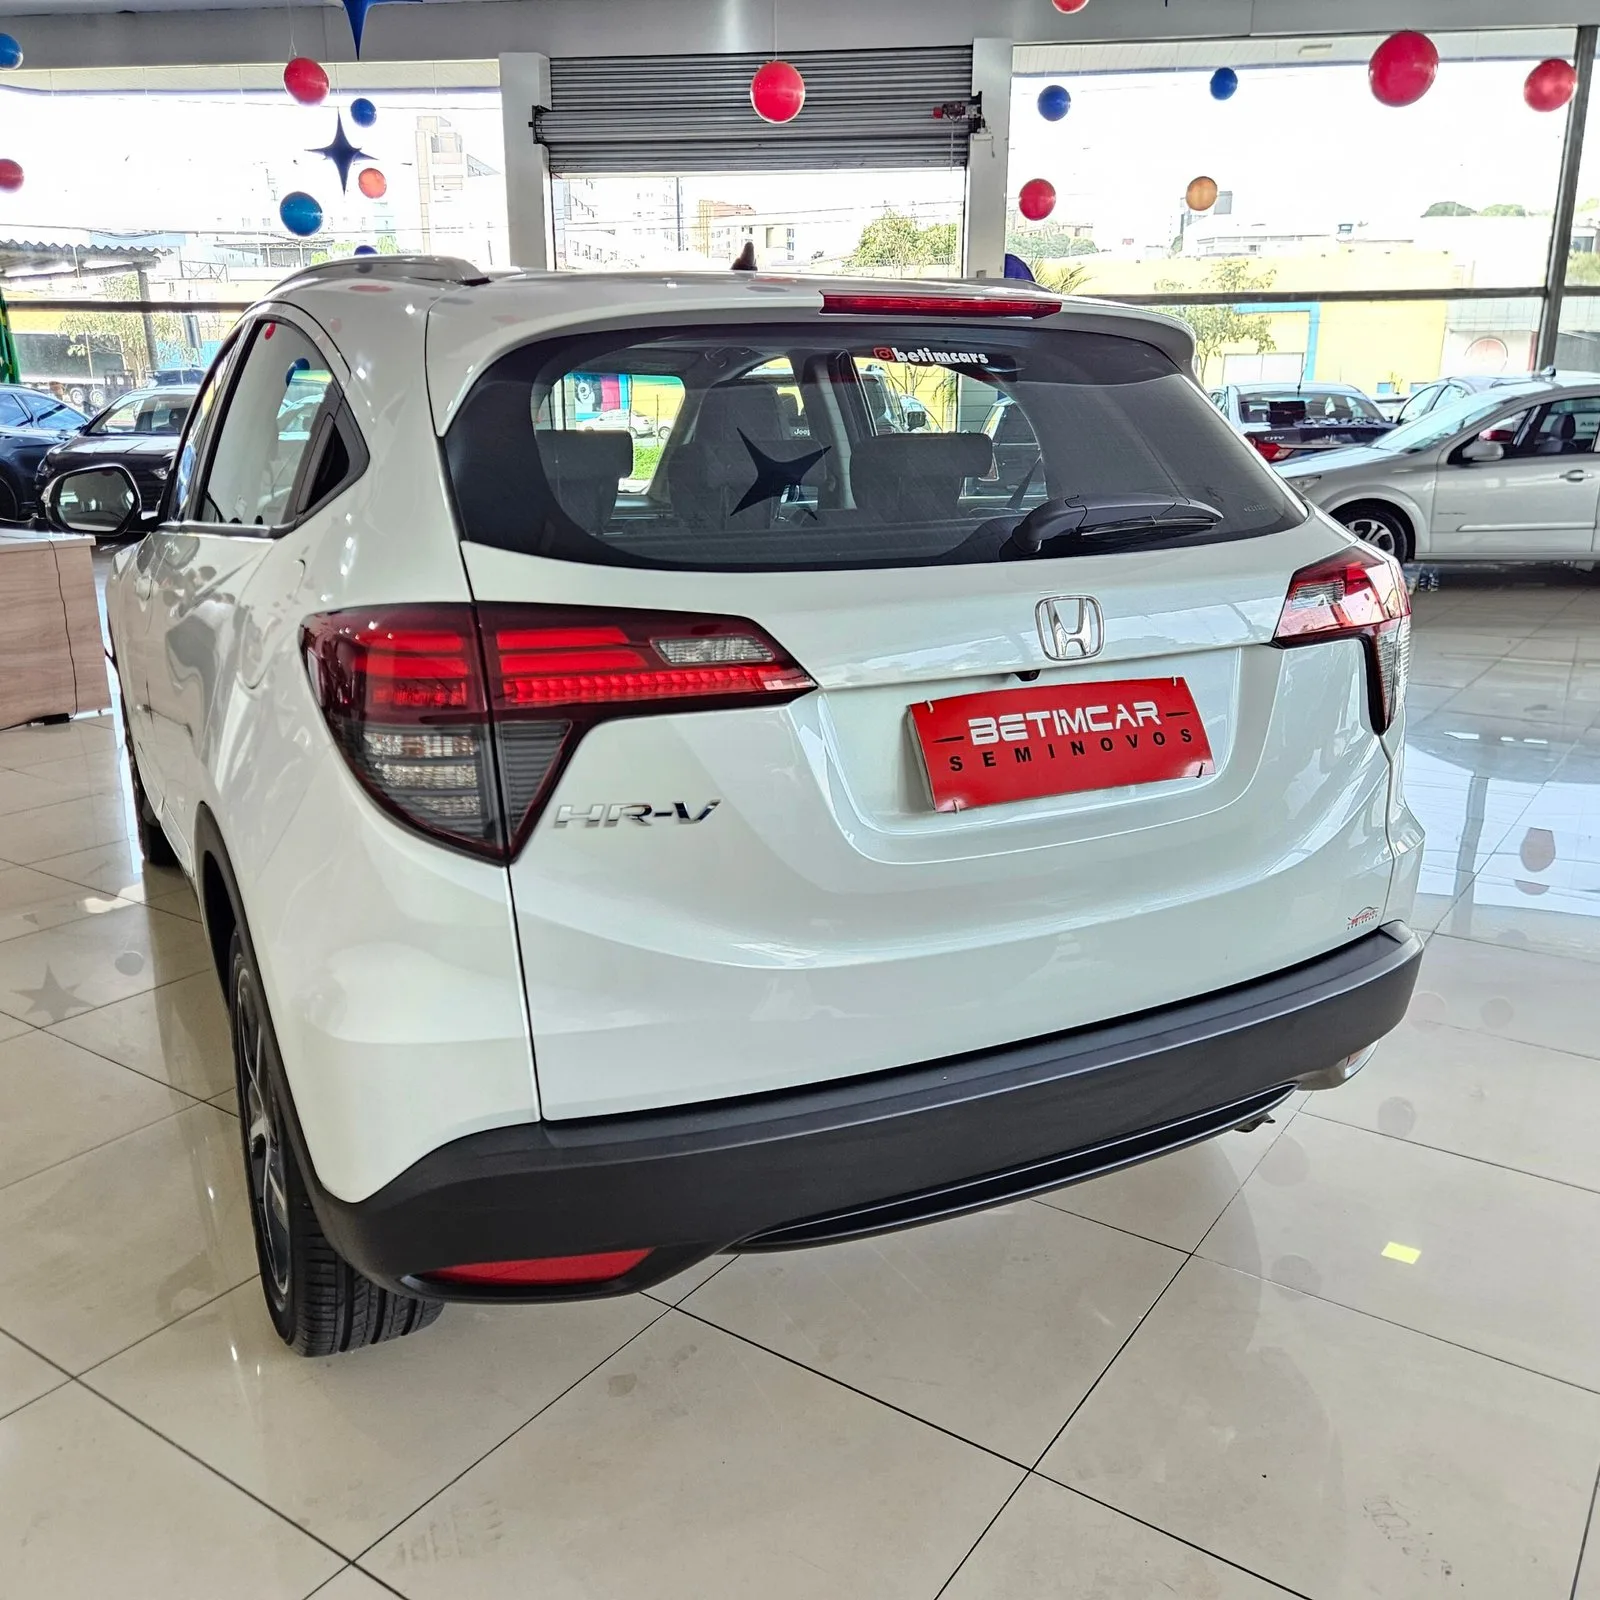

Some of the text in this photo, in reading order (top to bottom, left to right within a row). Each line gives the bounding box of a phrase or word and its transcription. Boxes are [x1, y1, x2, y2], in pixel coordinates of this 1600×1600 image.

[891, 347, 989, 364] betimcars
[967, 701, 1162, 746] BETIMCAR
[949, 728, 1193, 772] SEMINOVOS
[553, 800, 721, 829] HR-V
